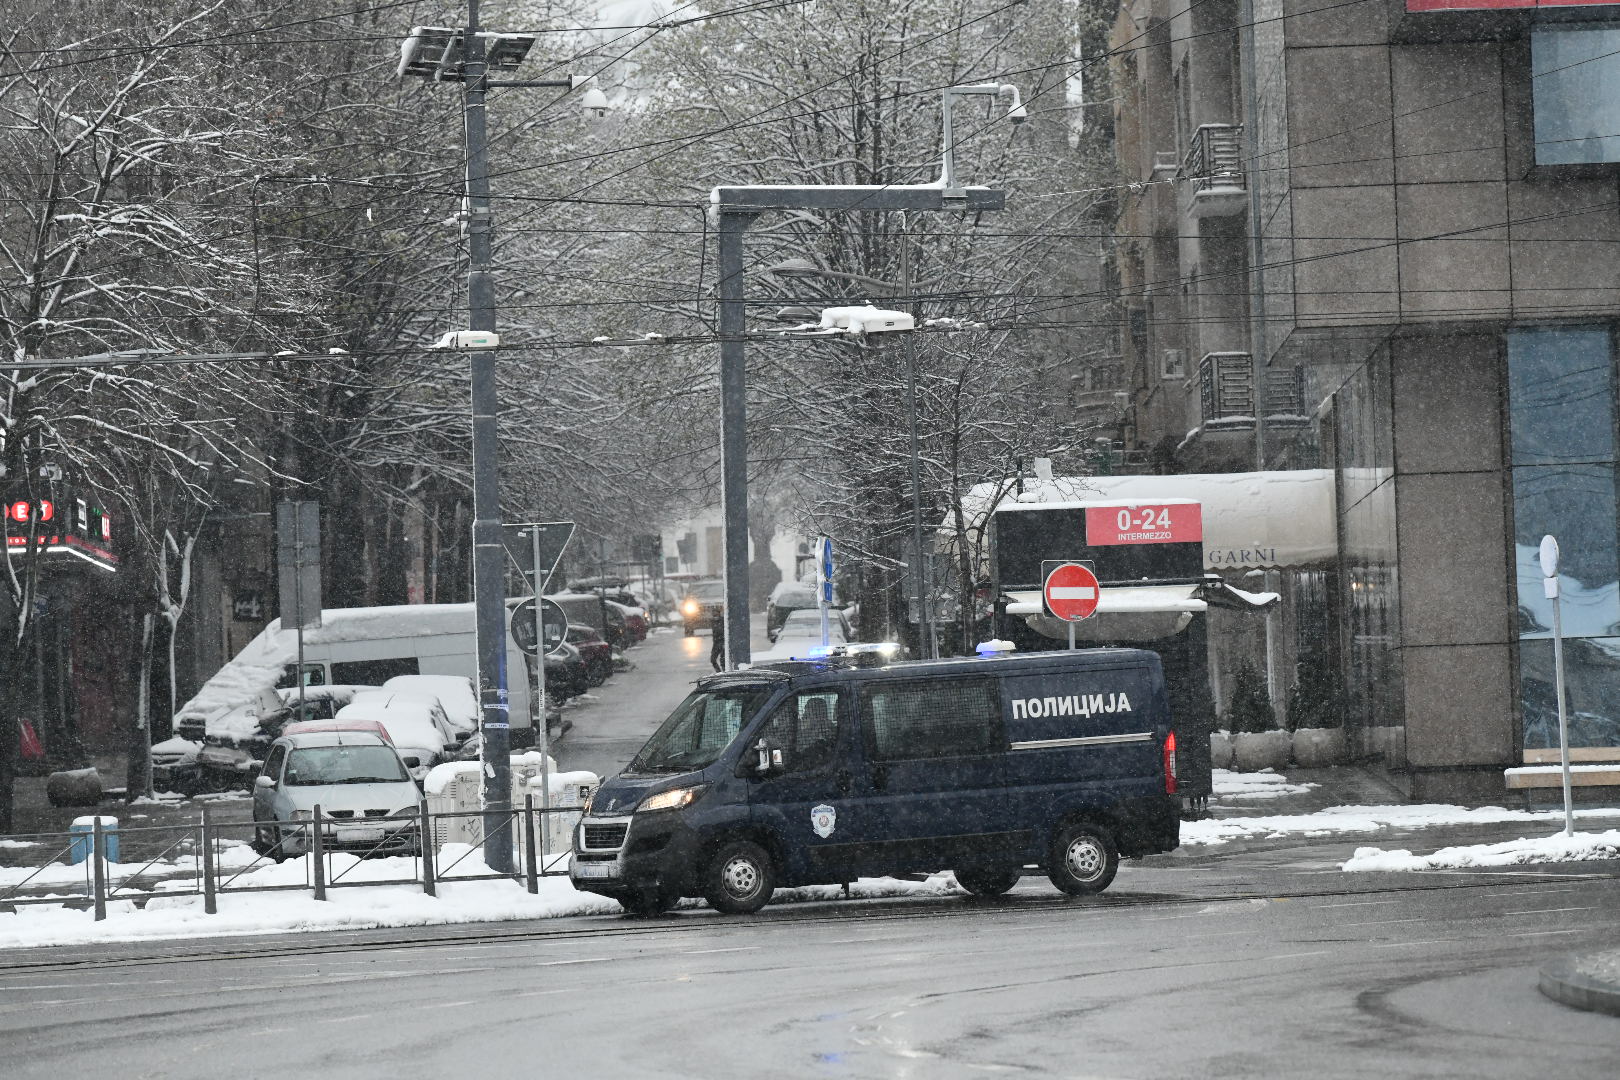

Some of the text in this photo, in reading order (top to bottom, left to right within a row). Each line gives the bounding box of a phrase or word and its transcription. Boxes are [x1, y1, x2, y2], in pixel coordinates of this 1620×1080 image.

[1117, 507, 1172, 531] 0-24
[1118, 531, 1172, 541] INTERMEZZO
[1208, 548, 1276, 564] GARNI
[1011, 692, 1132, 720] ПОЛИЦИЈА
